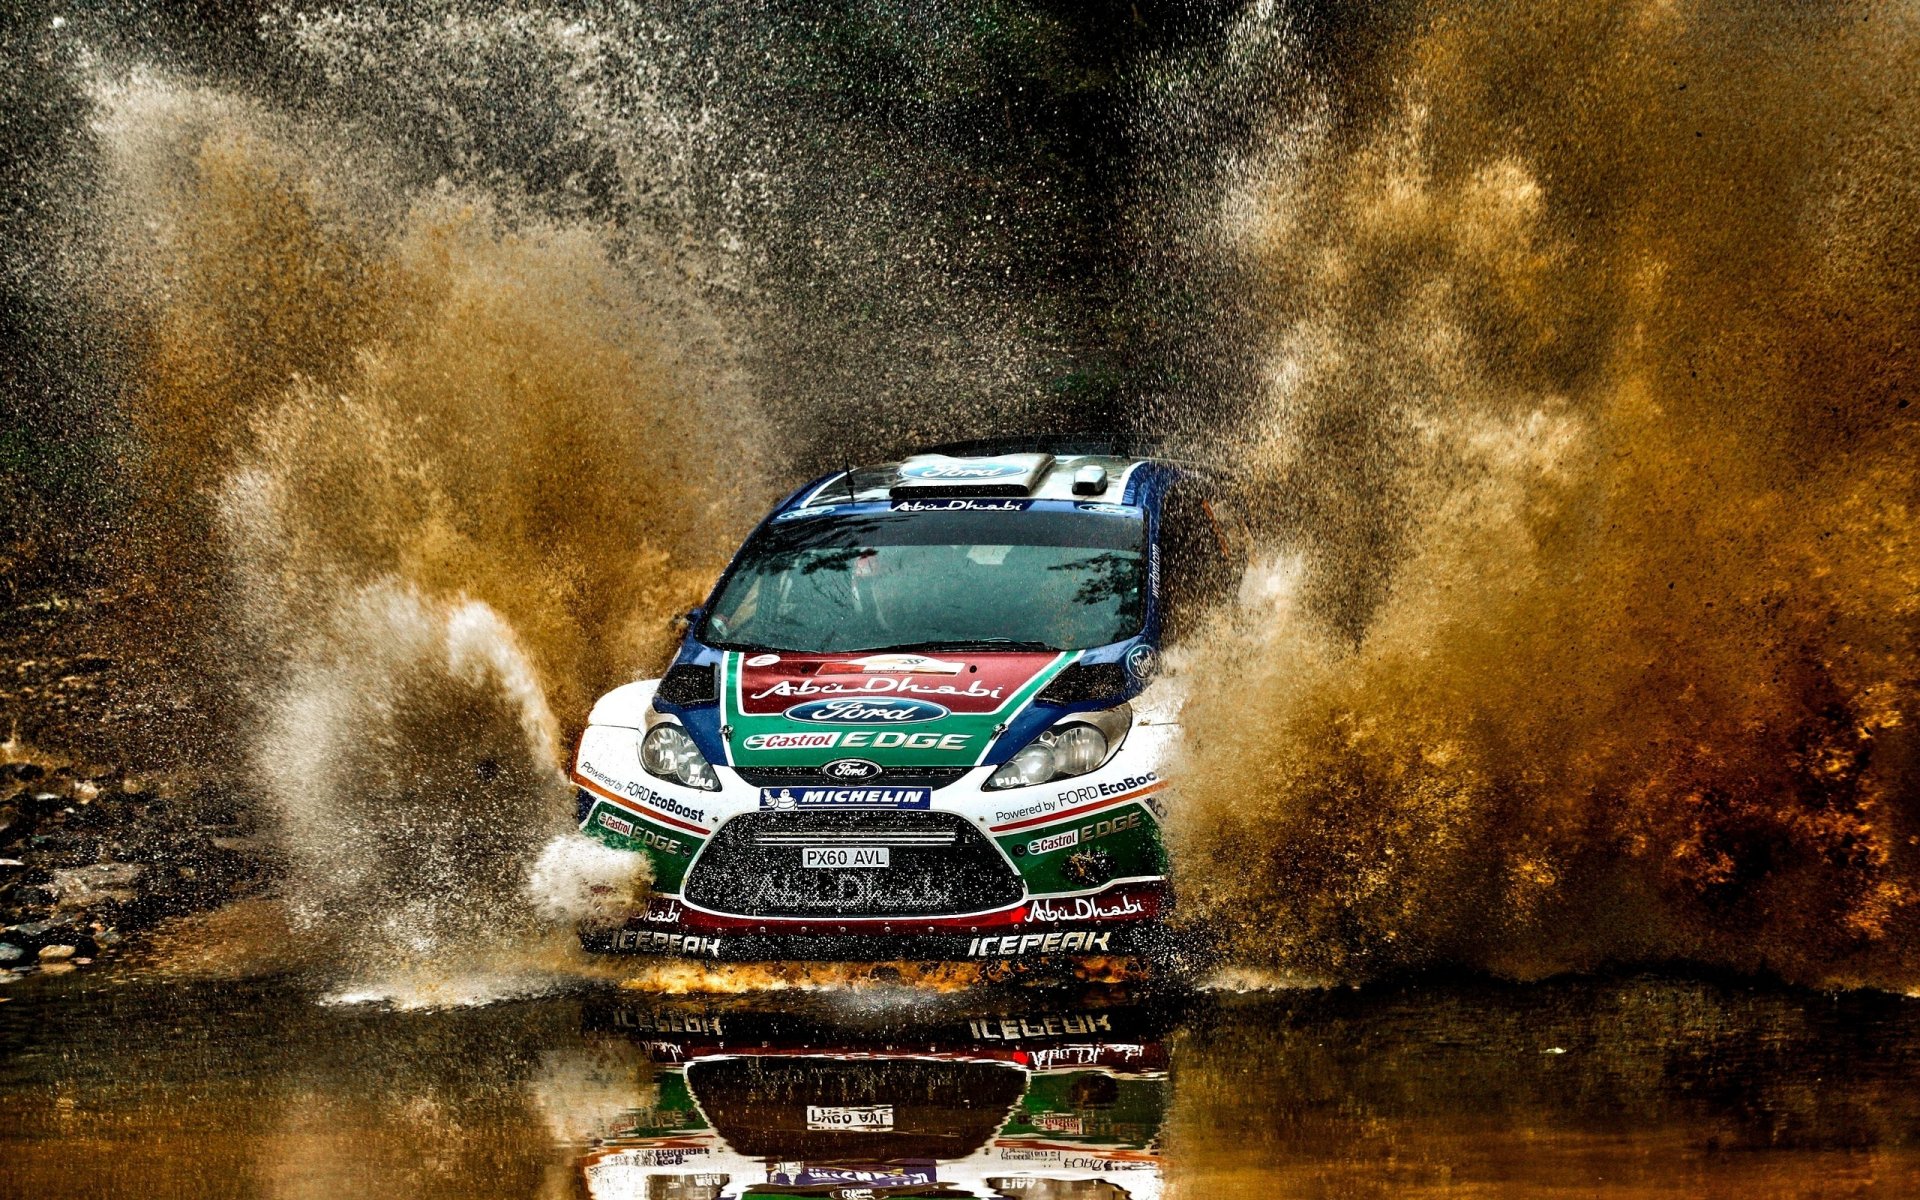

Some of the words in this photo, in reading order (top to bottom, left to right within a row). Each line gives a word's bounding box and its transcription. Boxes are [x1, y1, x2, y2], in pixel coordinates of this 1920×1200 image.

[921, 463, 1005, 478] Ford
[811, 700, 921, 721] Ford
[765, 733, 834, 748] Castrol
[838, 731, 974, 750] EDGE
[834, 762, 869, 777] Ford
[581, 761, 618, 787] Powered
[615, 781, 625, 793] by
[624, 781, 651, 802] FORD
[648, 791, 705, 823] EcoBoost
[995, 775, 1031, 787] PIAA
[801, 790, 924, 803] MICHELIN
[996, 802, 1043, 822] Powered
[1045, 800, 1056, 815] by
[1057, 786, 1099, 807] FORD
[1098, 771, 1158, 796] EcoBoo
[605, 816, 632, 836] Castrol
[632, 825, 682, 855] EDGE
[1040, 832, 1076, 851] Castrol
[1080, 811, 1142, 843] EDGE
[807, 850, 848, 865] PX60
[854, 850, 886, 865] AVL
[631, 899, 683, 922] habi
[611, 930, 721, 958] ICEPEAK
[967, 930, 1111, 958] ICEPEAK
